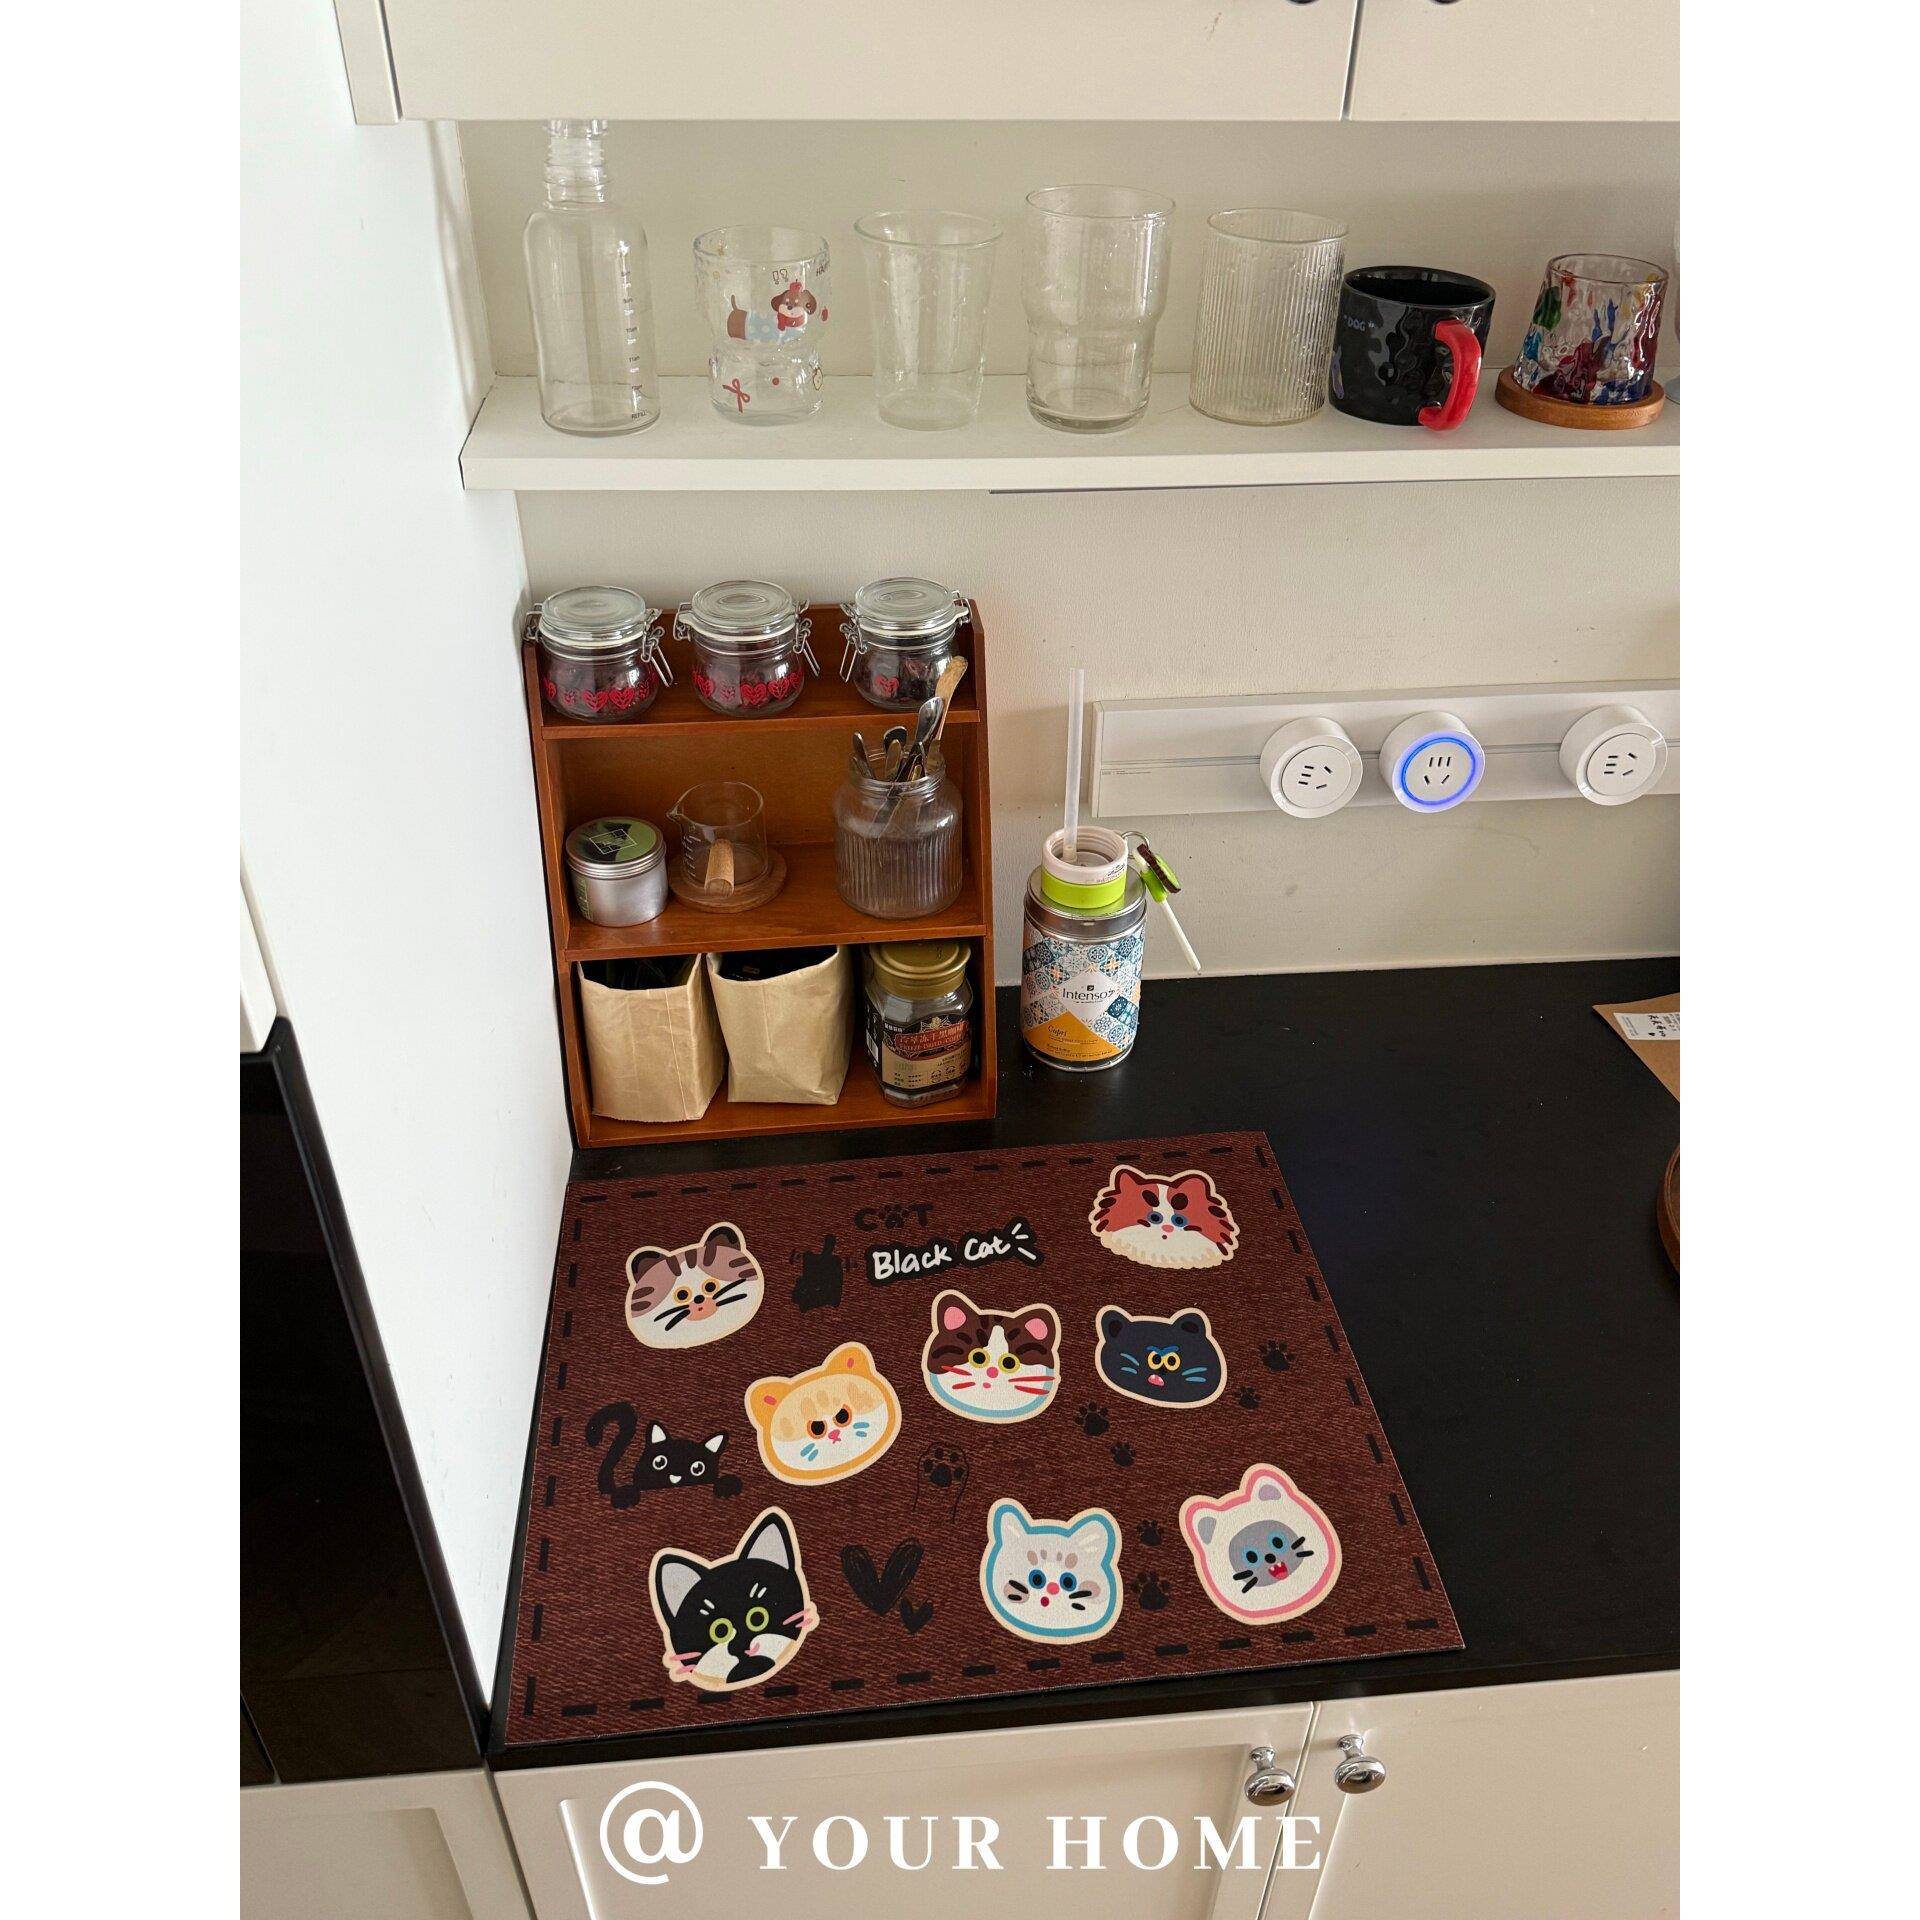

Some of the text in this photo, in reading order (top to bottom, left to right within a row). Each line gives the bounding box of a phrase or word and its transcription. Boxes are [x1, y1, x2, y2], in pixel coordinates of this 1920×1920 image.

[1347, 317, 1366, 332] DOG
[1063, 988, 1108, 1001] Intenso
[872, 1235, 1011, 1280] Black Cat
